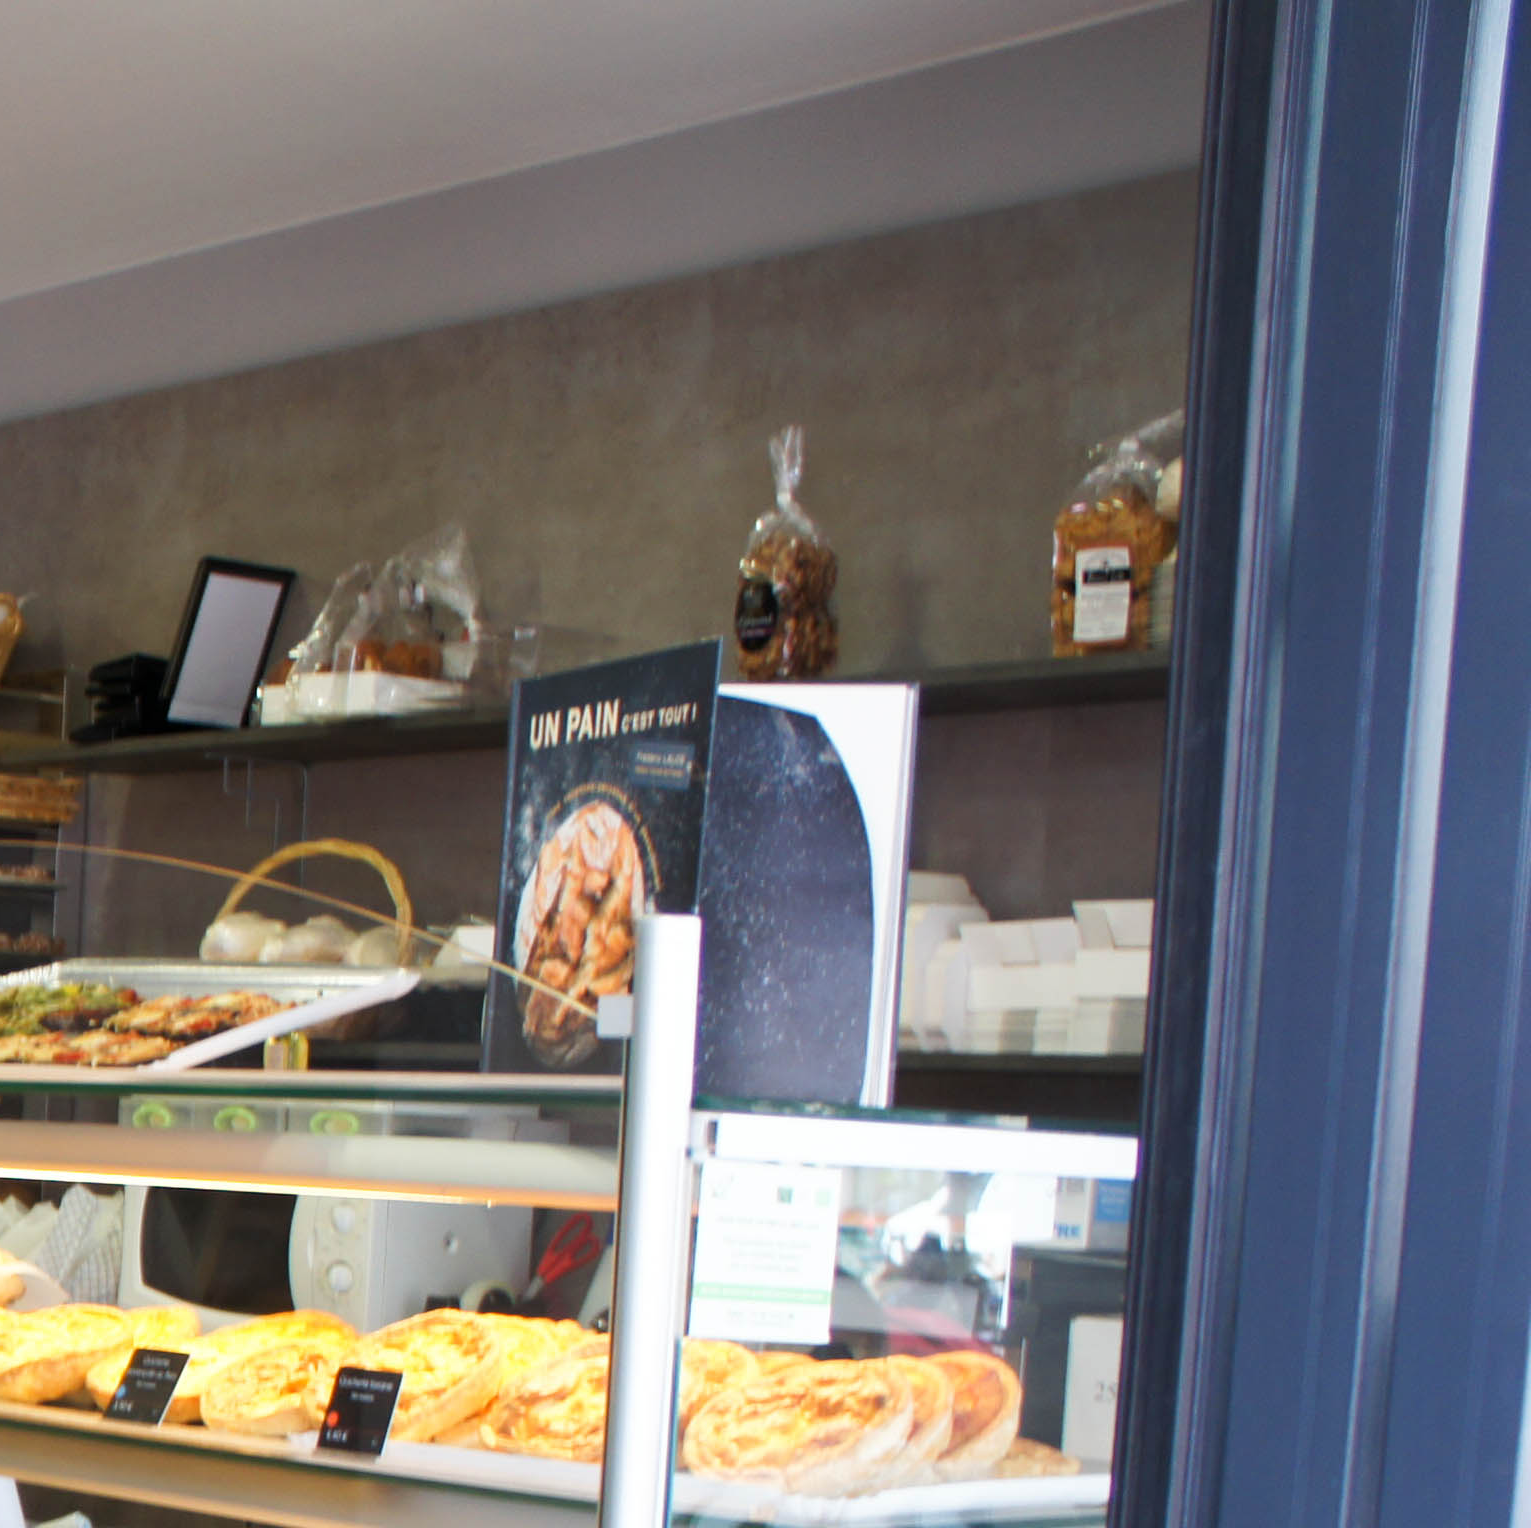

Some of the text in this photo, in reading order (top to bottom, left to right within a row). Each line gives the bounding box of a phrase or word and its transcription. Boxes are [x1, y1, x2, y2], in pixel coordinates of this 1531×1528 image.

[529, 710, 561, 751] UN
[566, 698, 621, 744] PAIN
[621, 709, 656, 734] C'EST
[658, 703, 691, 728] TOUT
